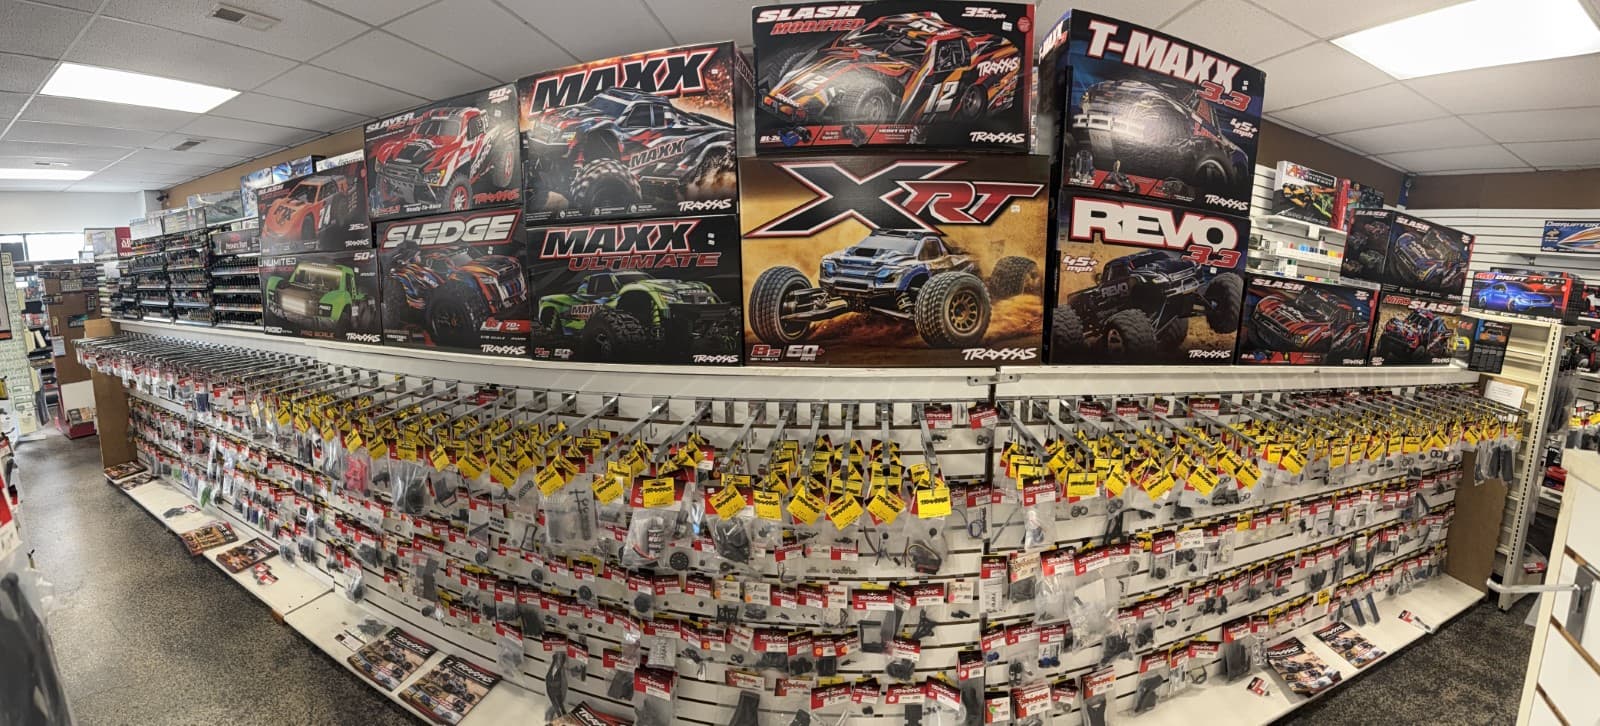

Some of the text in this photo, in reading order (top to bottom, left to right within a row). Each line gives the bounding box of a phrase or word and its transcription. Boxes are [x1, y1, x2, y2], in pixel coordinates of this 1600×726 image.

[756, 5, 862, 23] SLASH
[770, 19, 866, 35] MODIFIED
[1087, 20, 1241, 95] T-MAXX
[978, 57, 1021, 77] TRAXXAS
[530, 49, 718, 115] MAXX
[923, 80, 960, 115] 12
[1197, 80, 1252, 112] 3.3
[366, 112, 415, 133] SLAYER
[1230, 118, 1259, 134] 45+
[969, 131, 1026, 144] TRAXXAS
[628, 137, 686, 168] MAXX
[678, 198, 732, 212] TRAXXAS
[743, 160, 1047, 238] XRT
[1204, 194, 1249, 211] TRAXXAS
[382, 212, 519, 250] SLEDGE
[1071, 197, 1238, 249] REVO
[539, 220, 700, 259] MAXX
[258, 257, 297, 267] UNLIMITED
[353, 252, 375, 261] 50+
[568, 252, 722, 272] ULTIMATE
[1063, 255, 1098, 266] 45+
[1182, 245, 1241, 269] 3.3
[1067, 265, 1093, 273] mph
[1252, 279, 1305, 291] SLASH
[1408, 300, 1457, 313] SLASH
[346, 333, 381, 342] TRAXXAS
[481, 344, 526, 355] TRAXXAS
[786, 345, 825, 357] 60+
[961, 348, 1038, 360] TRAXXAS
[1188, 350, 1232, 359] TRAXXAS
[693, 354, 738, 363] TRAXXAS
